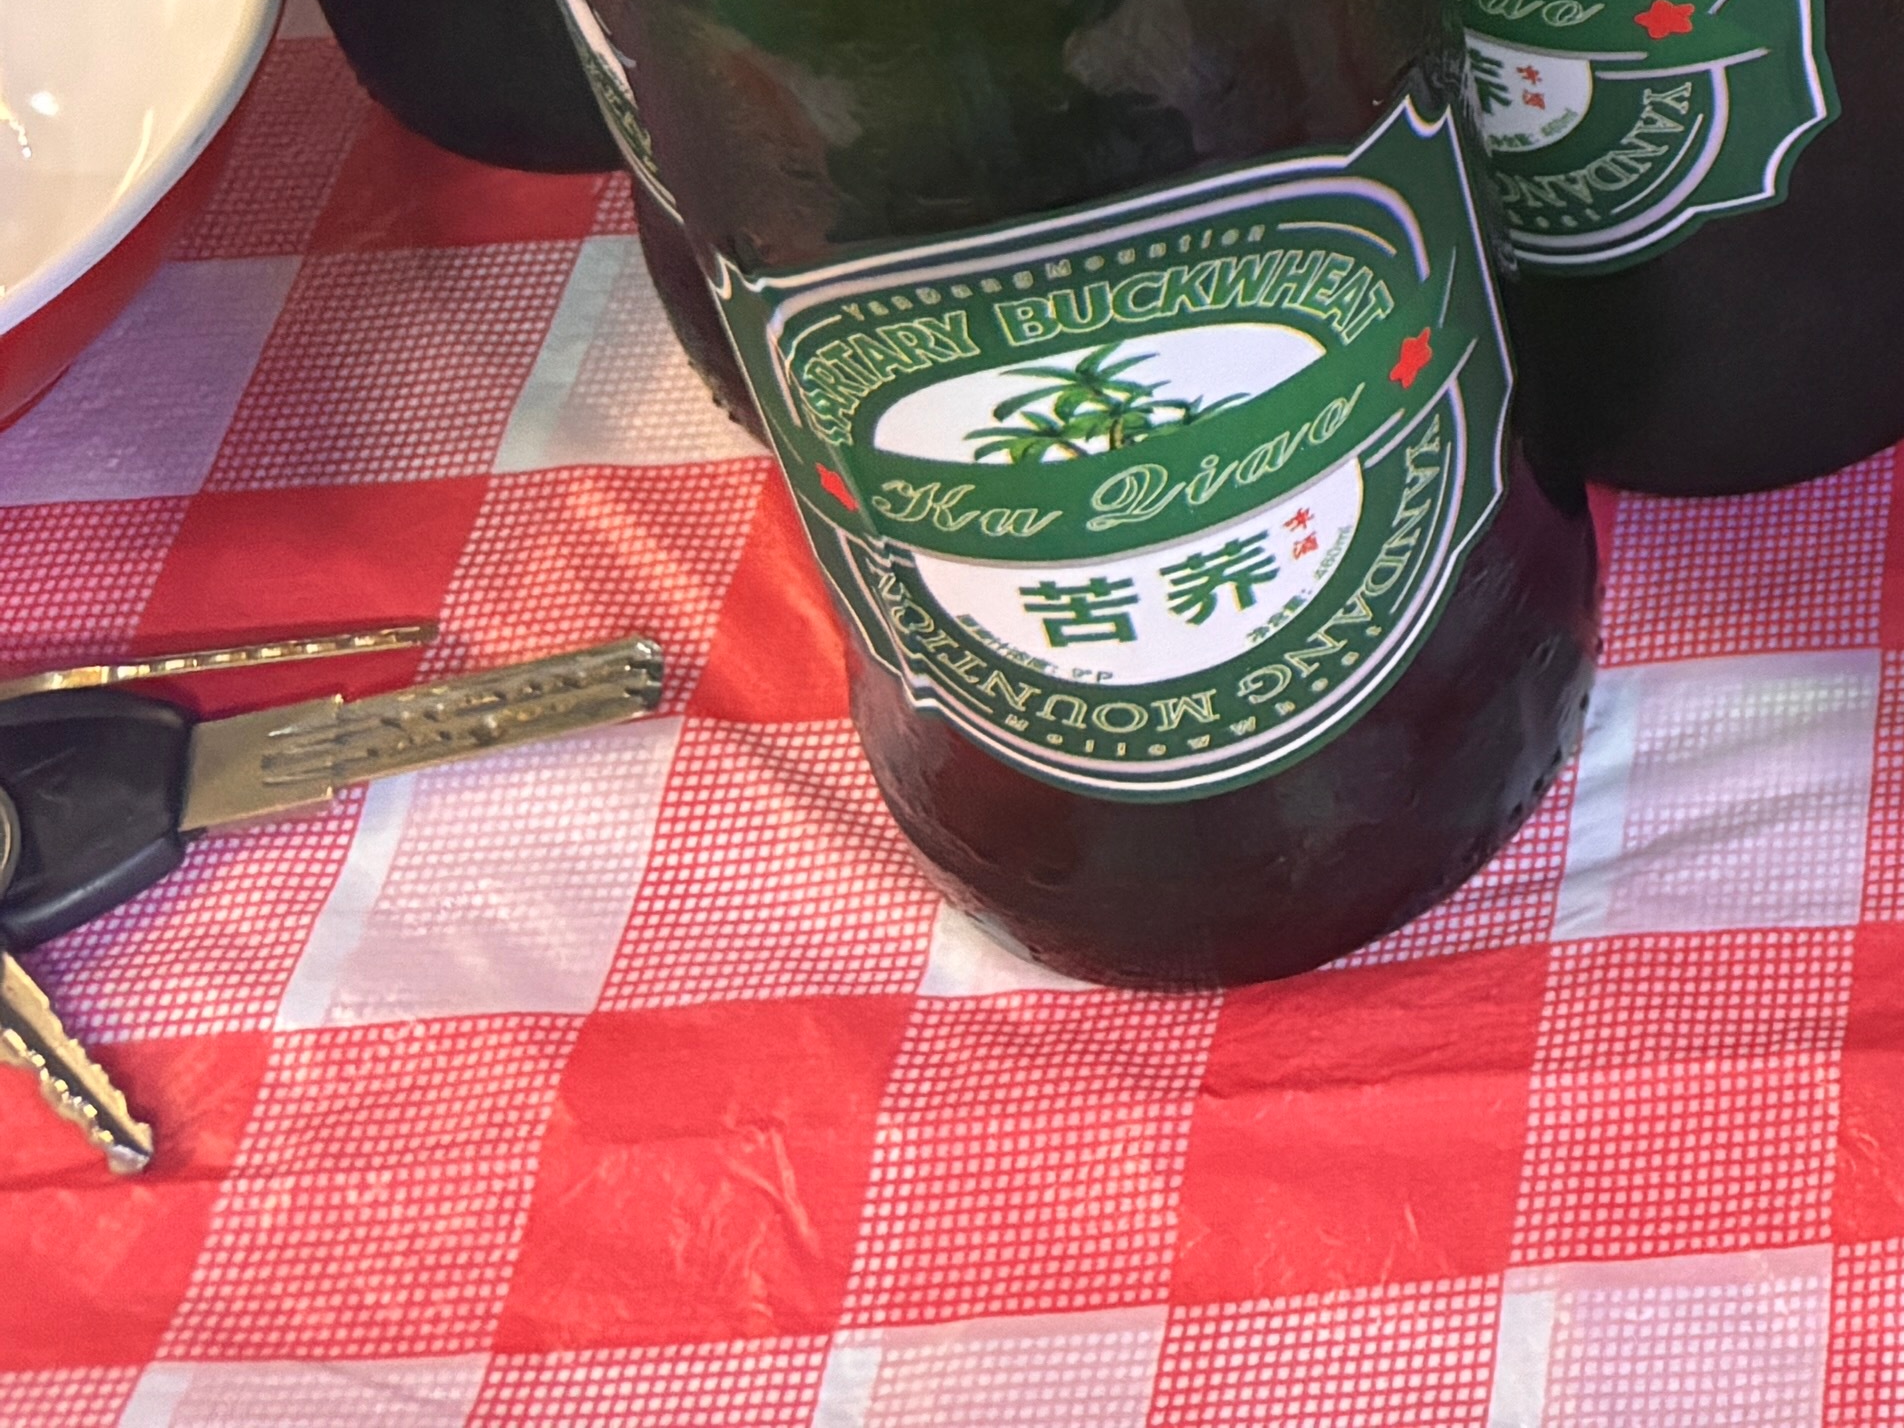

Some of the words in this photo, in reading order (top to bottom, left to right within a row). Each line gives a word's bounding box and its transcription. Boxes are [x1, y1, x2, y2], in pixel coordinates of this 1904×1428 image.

[994, 249, 1395, 346] BUCKWHEAT
[1017, 531, 1282, 649] 苦荞
[1237, 411, 1443, 707] YANDANG
[868, 559, 1221, 734] MOUNTION
